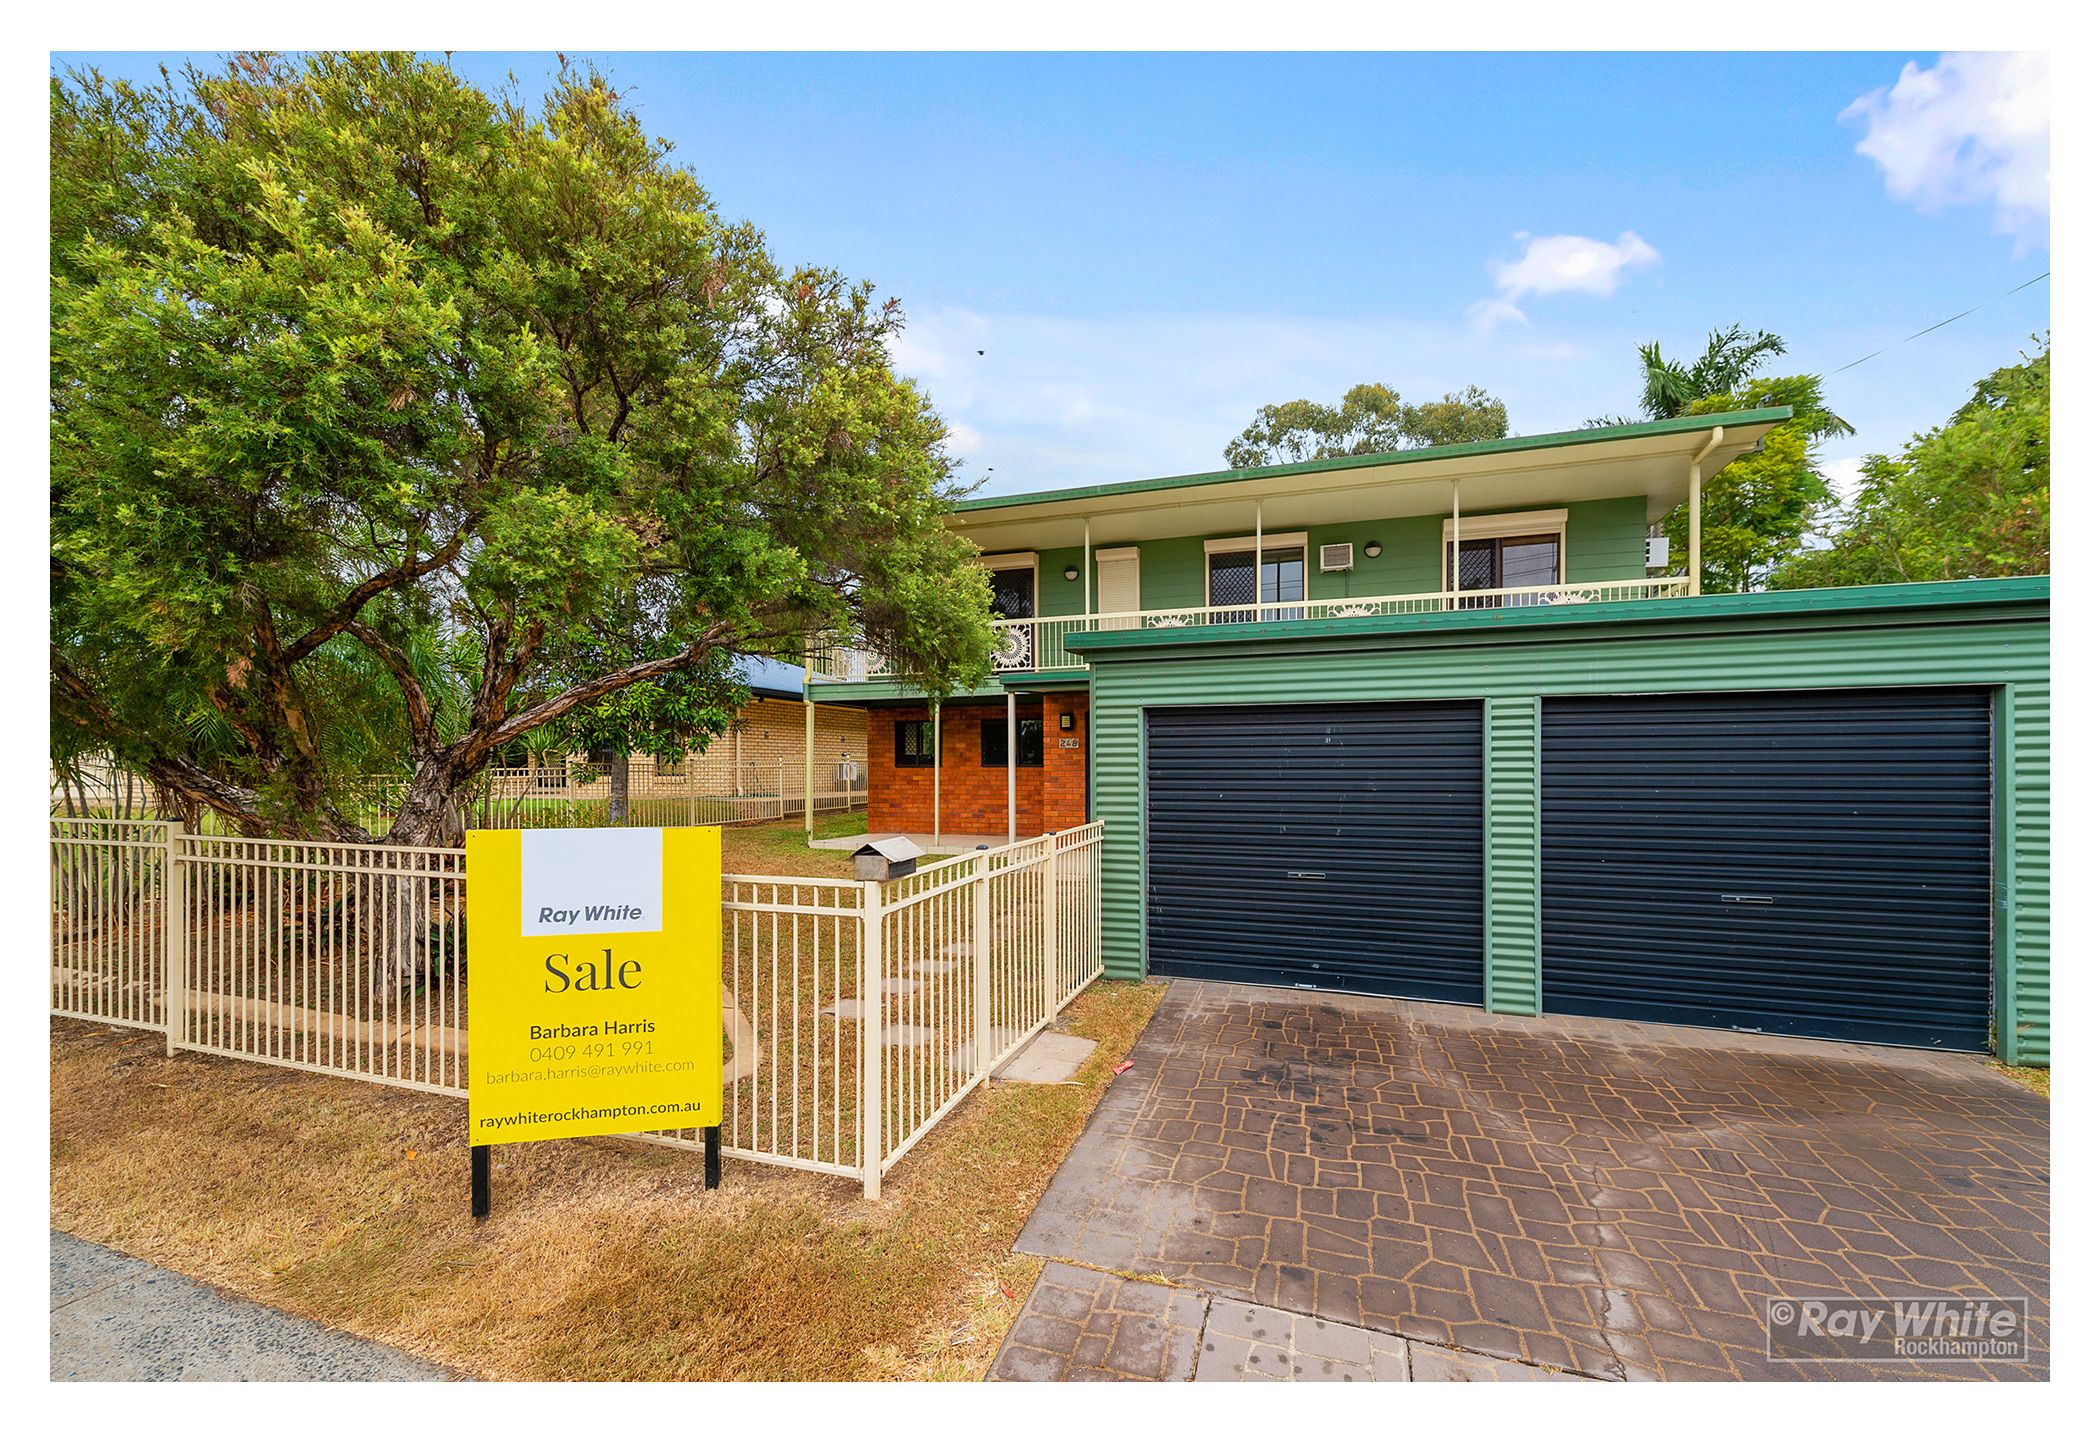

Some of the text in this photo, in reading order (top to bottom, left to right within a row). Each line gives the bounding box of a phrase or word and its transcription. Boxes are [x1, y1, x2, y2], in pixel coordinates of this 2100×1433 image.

[538, 904, 643, 925] Ray White
[544, 948, 642, 994] Sale
[529, 1018, 655, 1040] Barbara Harris
[529, 1040, 654, 1063] 0409 491 991
[486, 1059, 695, 1085] barbara.harris@raywhite.com
[479, 1101, 701, 1128] raywhiterockhampton.com.au
